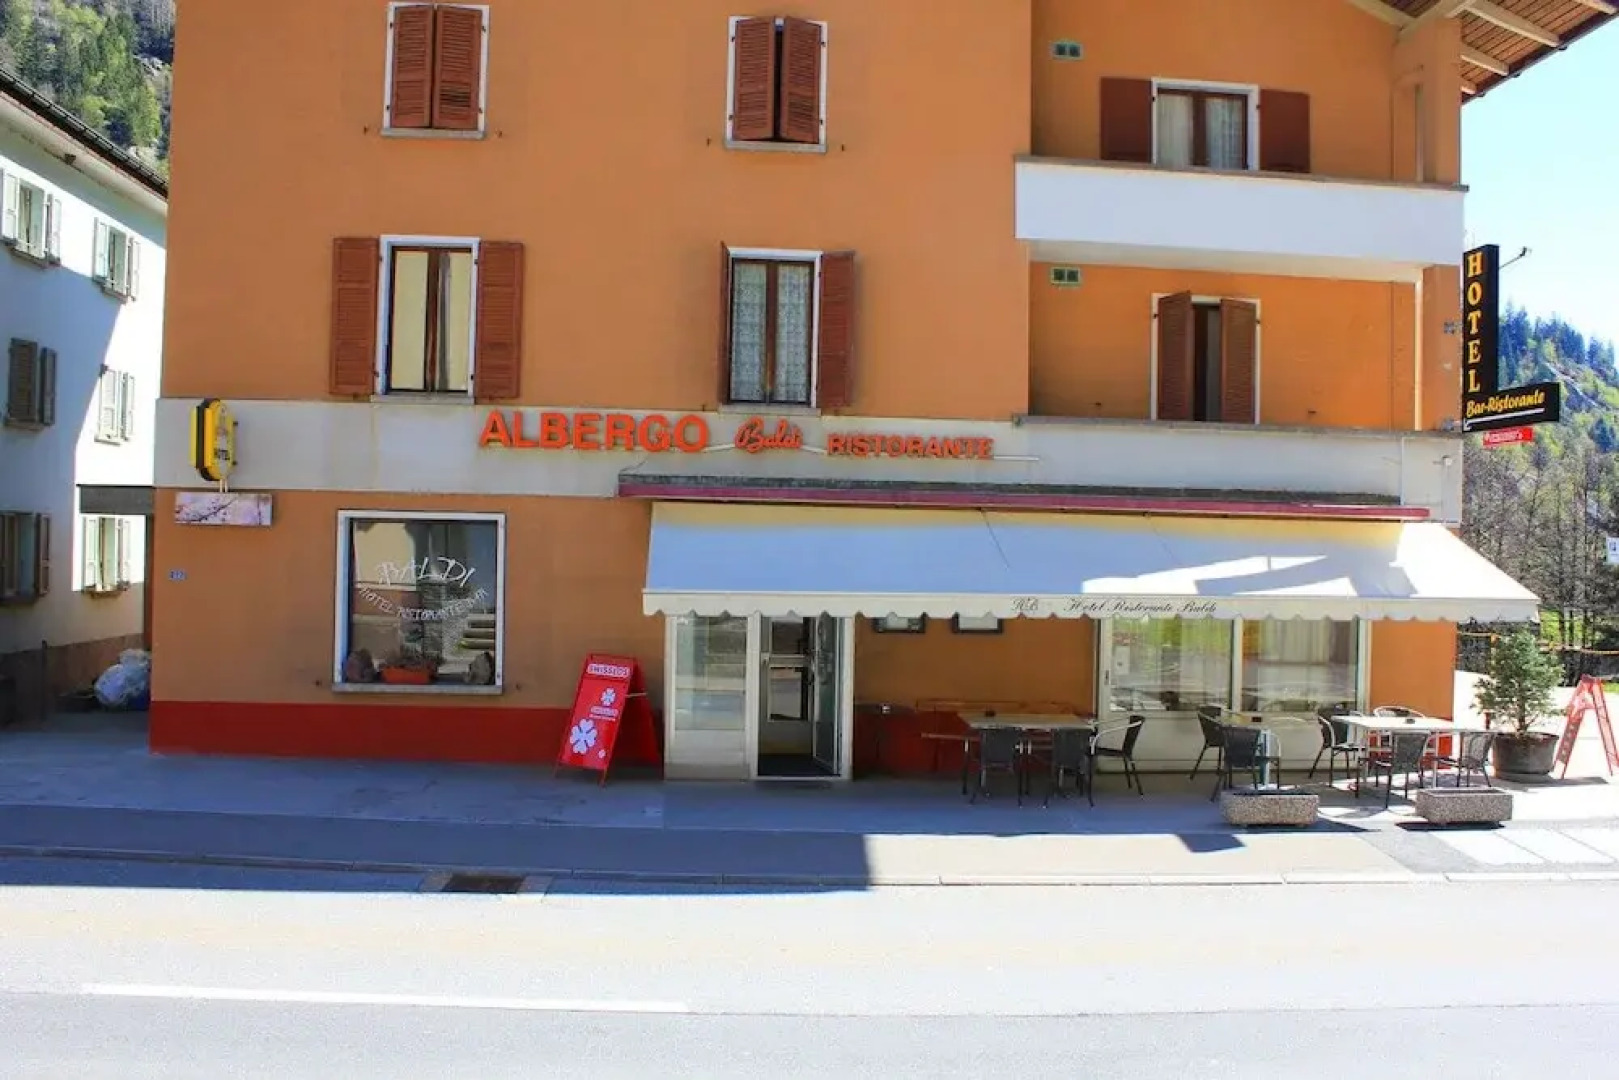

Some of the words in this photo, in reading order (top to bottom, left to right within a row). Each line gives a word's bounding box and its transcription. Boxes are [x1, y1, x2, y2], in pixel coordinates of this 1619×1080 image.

[1466, 251, 1483, 393] HOTEL
[1466, 389, 1546, 418] Bar-Ristorante
[480, 410, 710, 453] ALBERGO
[734, 416, 804, 453] Baldi
[827, 433, 994, 460] RISTORANTE
[377, 556, 476, 587] BALDI
[359, 586, 396, 614] HOTEL
[1063, 598, 1105, 612] Hotel
[1106, 599, 1173, 613] Ristorante
